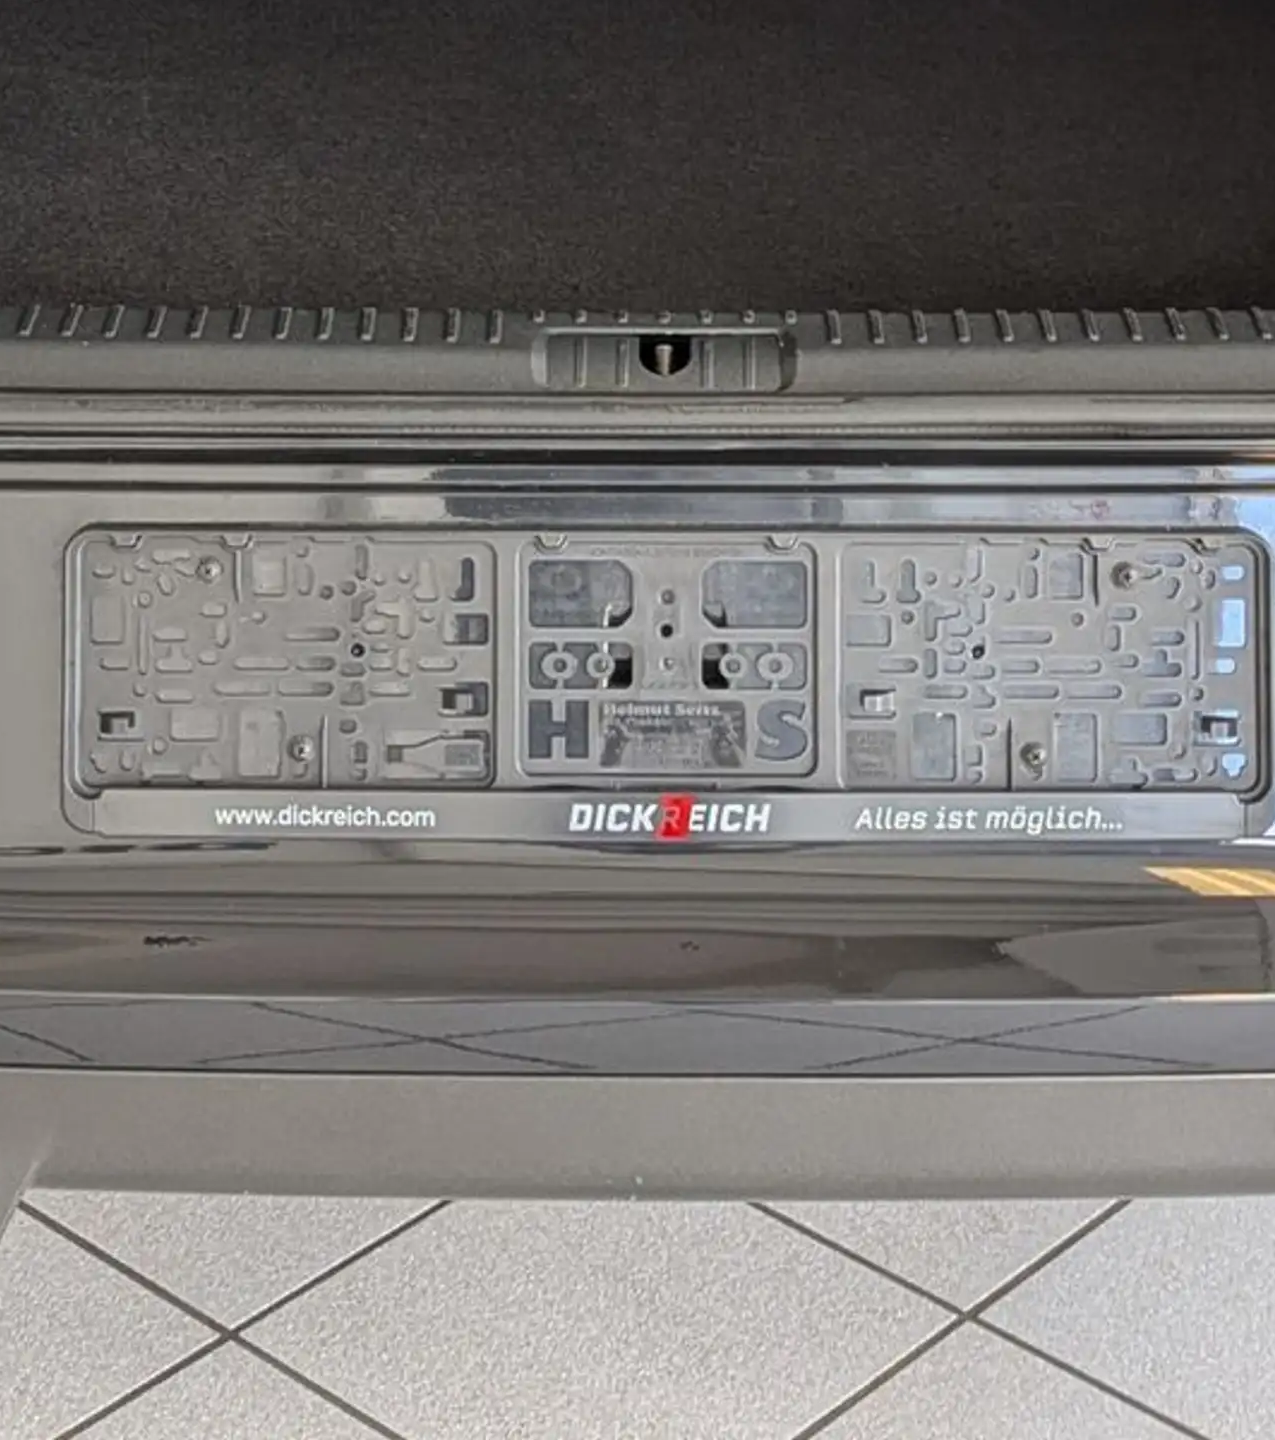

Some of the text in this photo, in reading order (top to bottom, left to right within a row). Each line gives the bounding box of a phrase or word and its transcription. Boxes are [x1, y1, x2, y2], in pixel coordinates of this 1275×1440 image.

[528, 700, 589, 759] H
[755, 699, 809, 761] S
[214, 803, 437, 827] www.dickreich.com
[568, 802, 772, 832] DICKREICH
[854, 806, 1124, 836] Alles ist möglich...
